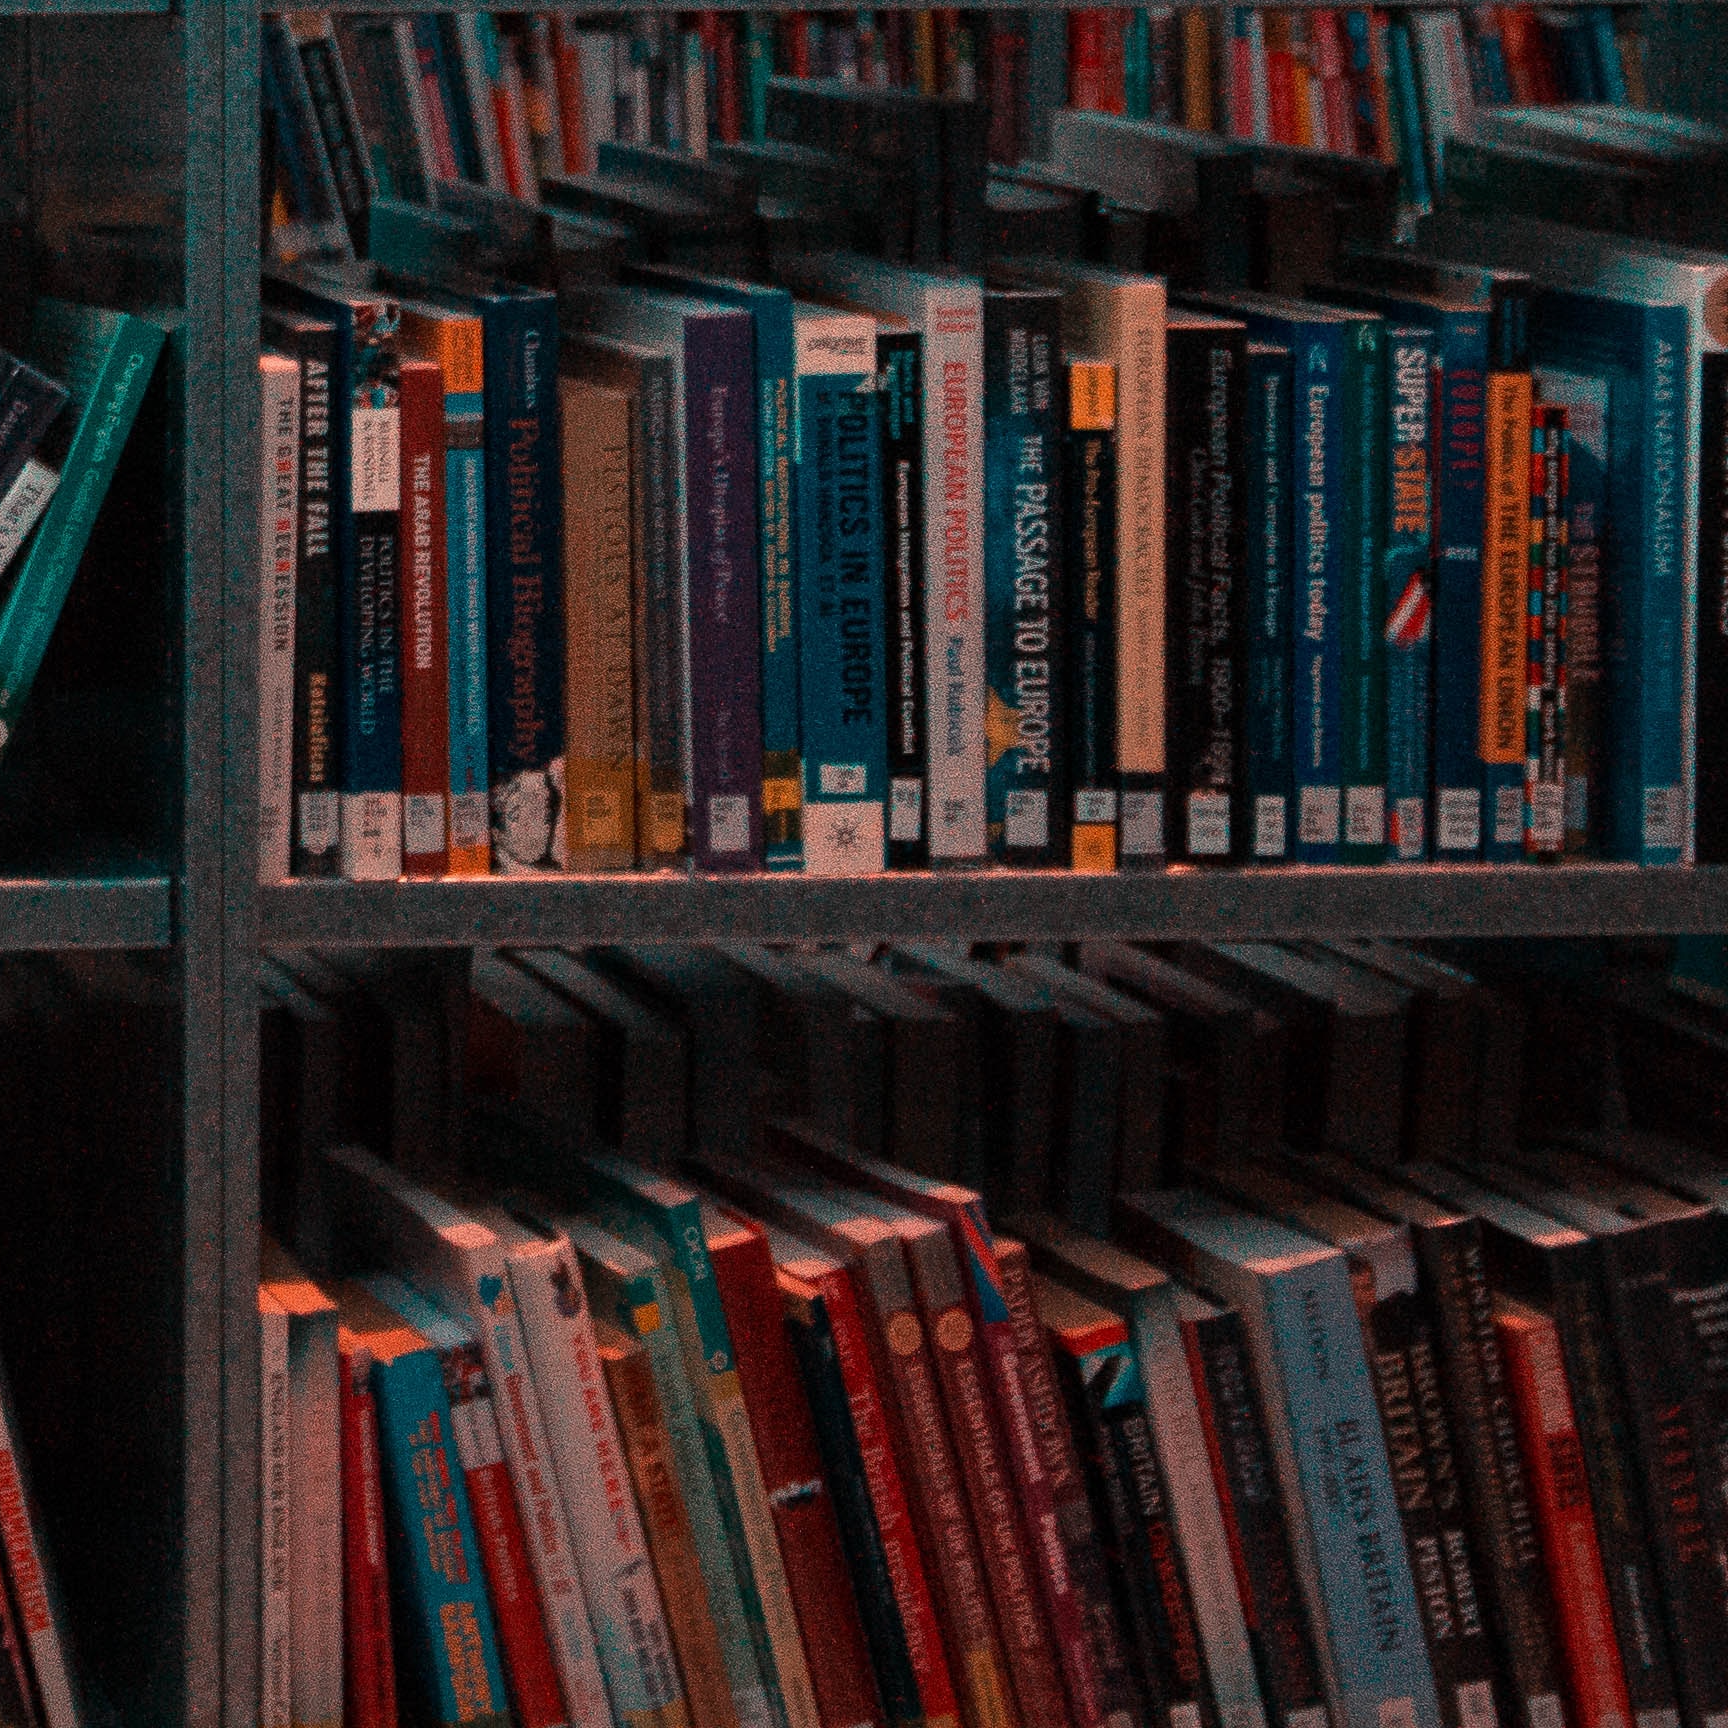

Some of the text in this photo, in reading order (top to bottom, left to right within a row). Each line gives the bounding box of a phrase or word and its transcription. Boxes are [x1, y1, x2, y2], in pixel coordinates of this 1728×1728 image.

[306, 360, 329, 557] AFTER THE FALL
[944, 363, 967, 501] EUROPEAN
[1303, 387, 1328, 640] European politics today
[1654, 340, 1673, 575] ARAB NATIONALISM
[415, 455, 431, 669] THE ARAB REVOLUTION
[507, 418, 544, 763] Political Biography
[838, 392, 872, 725] POLITICS IN EUROPE
[946, 510, 969, 620] POLITICS
[947, 638, 963, 676] Paul
[1014, 435, 1051, 774] THE PASSAGE TO EUROPE
[1377, 1351, 1426, 1512] BRITAIN
[1465, 1247, 1535, 1564] WINSTON CHURCHILL
[1335, 1419, 1399, 1652] BLAIR'S BRITAIN
[1416, 1535, 1453, 1640] PESTON
[1443, 1530, 1478, 1636] ROBERT
